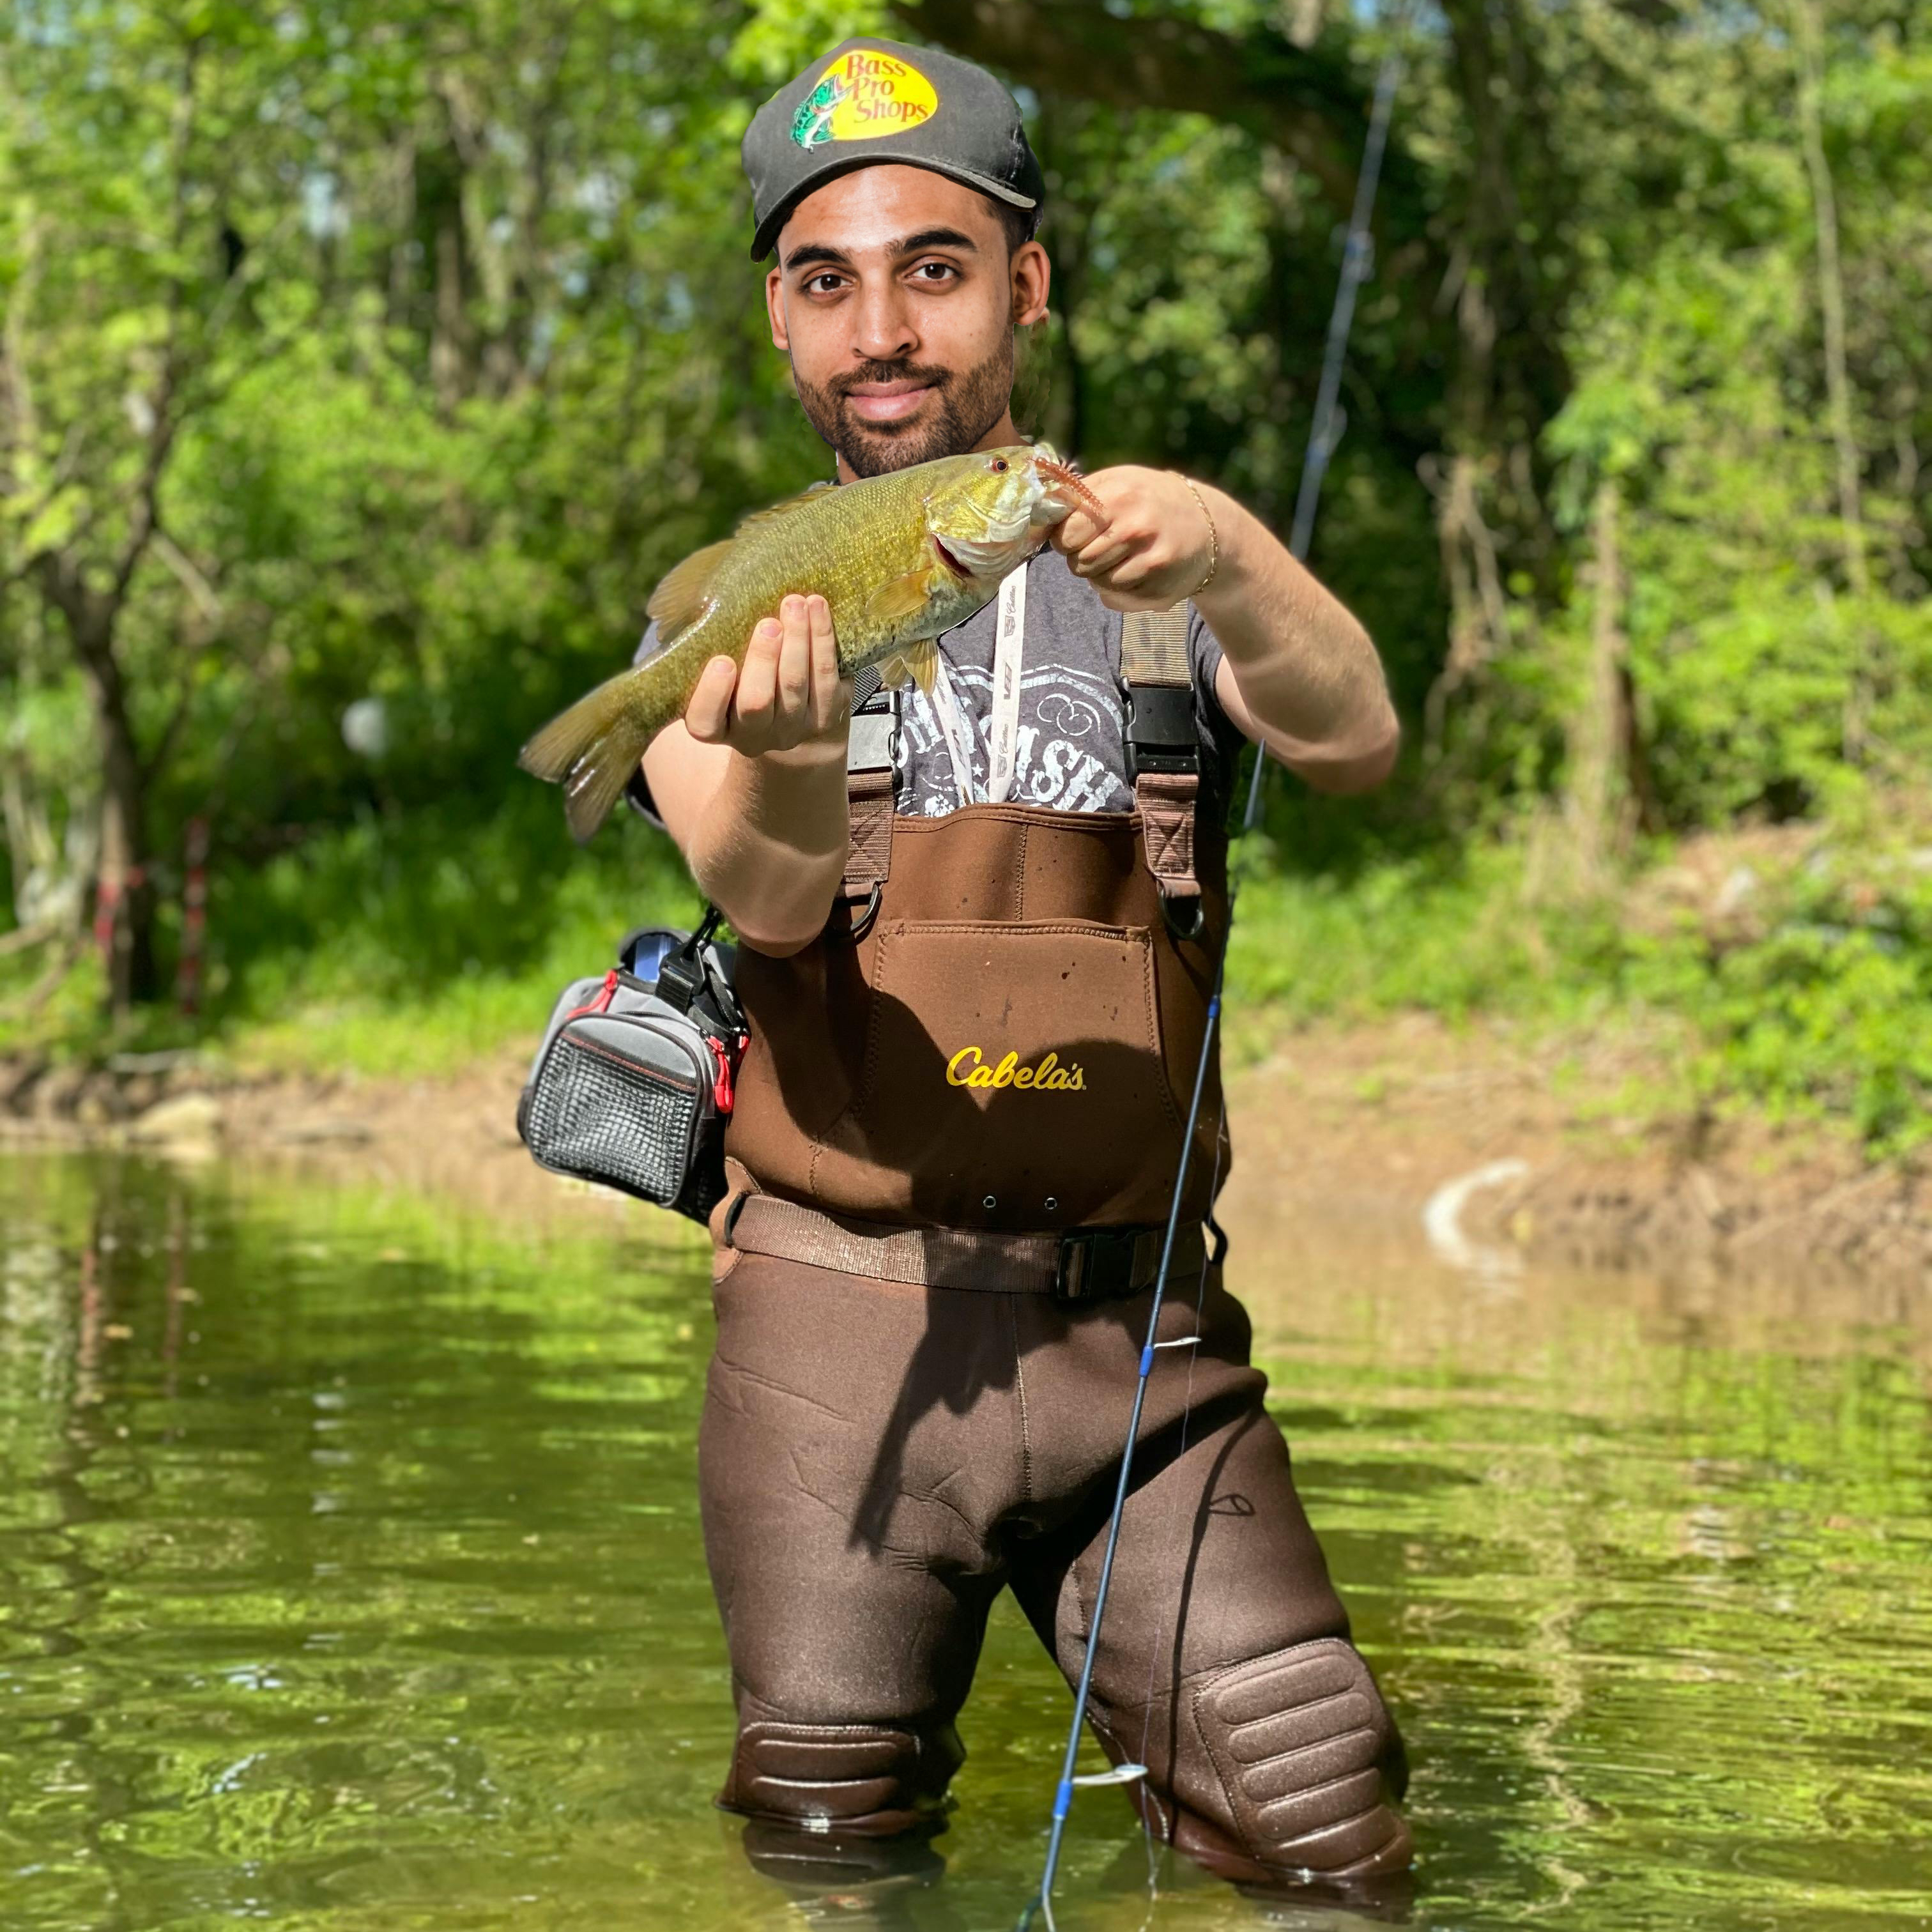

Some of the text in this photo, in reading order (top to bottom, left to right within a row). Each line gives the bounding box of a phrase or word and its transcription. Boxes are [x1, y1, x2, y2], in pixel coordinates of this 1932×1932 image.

[846, 54, 907, 80] Bass
[852, 77, 895, 102] Pro
[854, 98, 929, 123] Shops
[946, 1046, 1084, 1091] Cabela's
